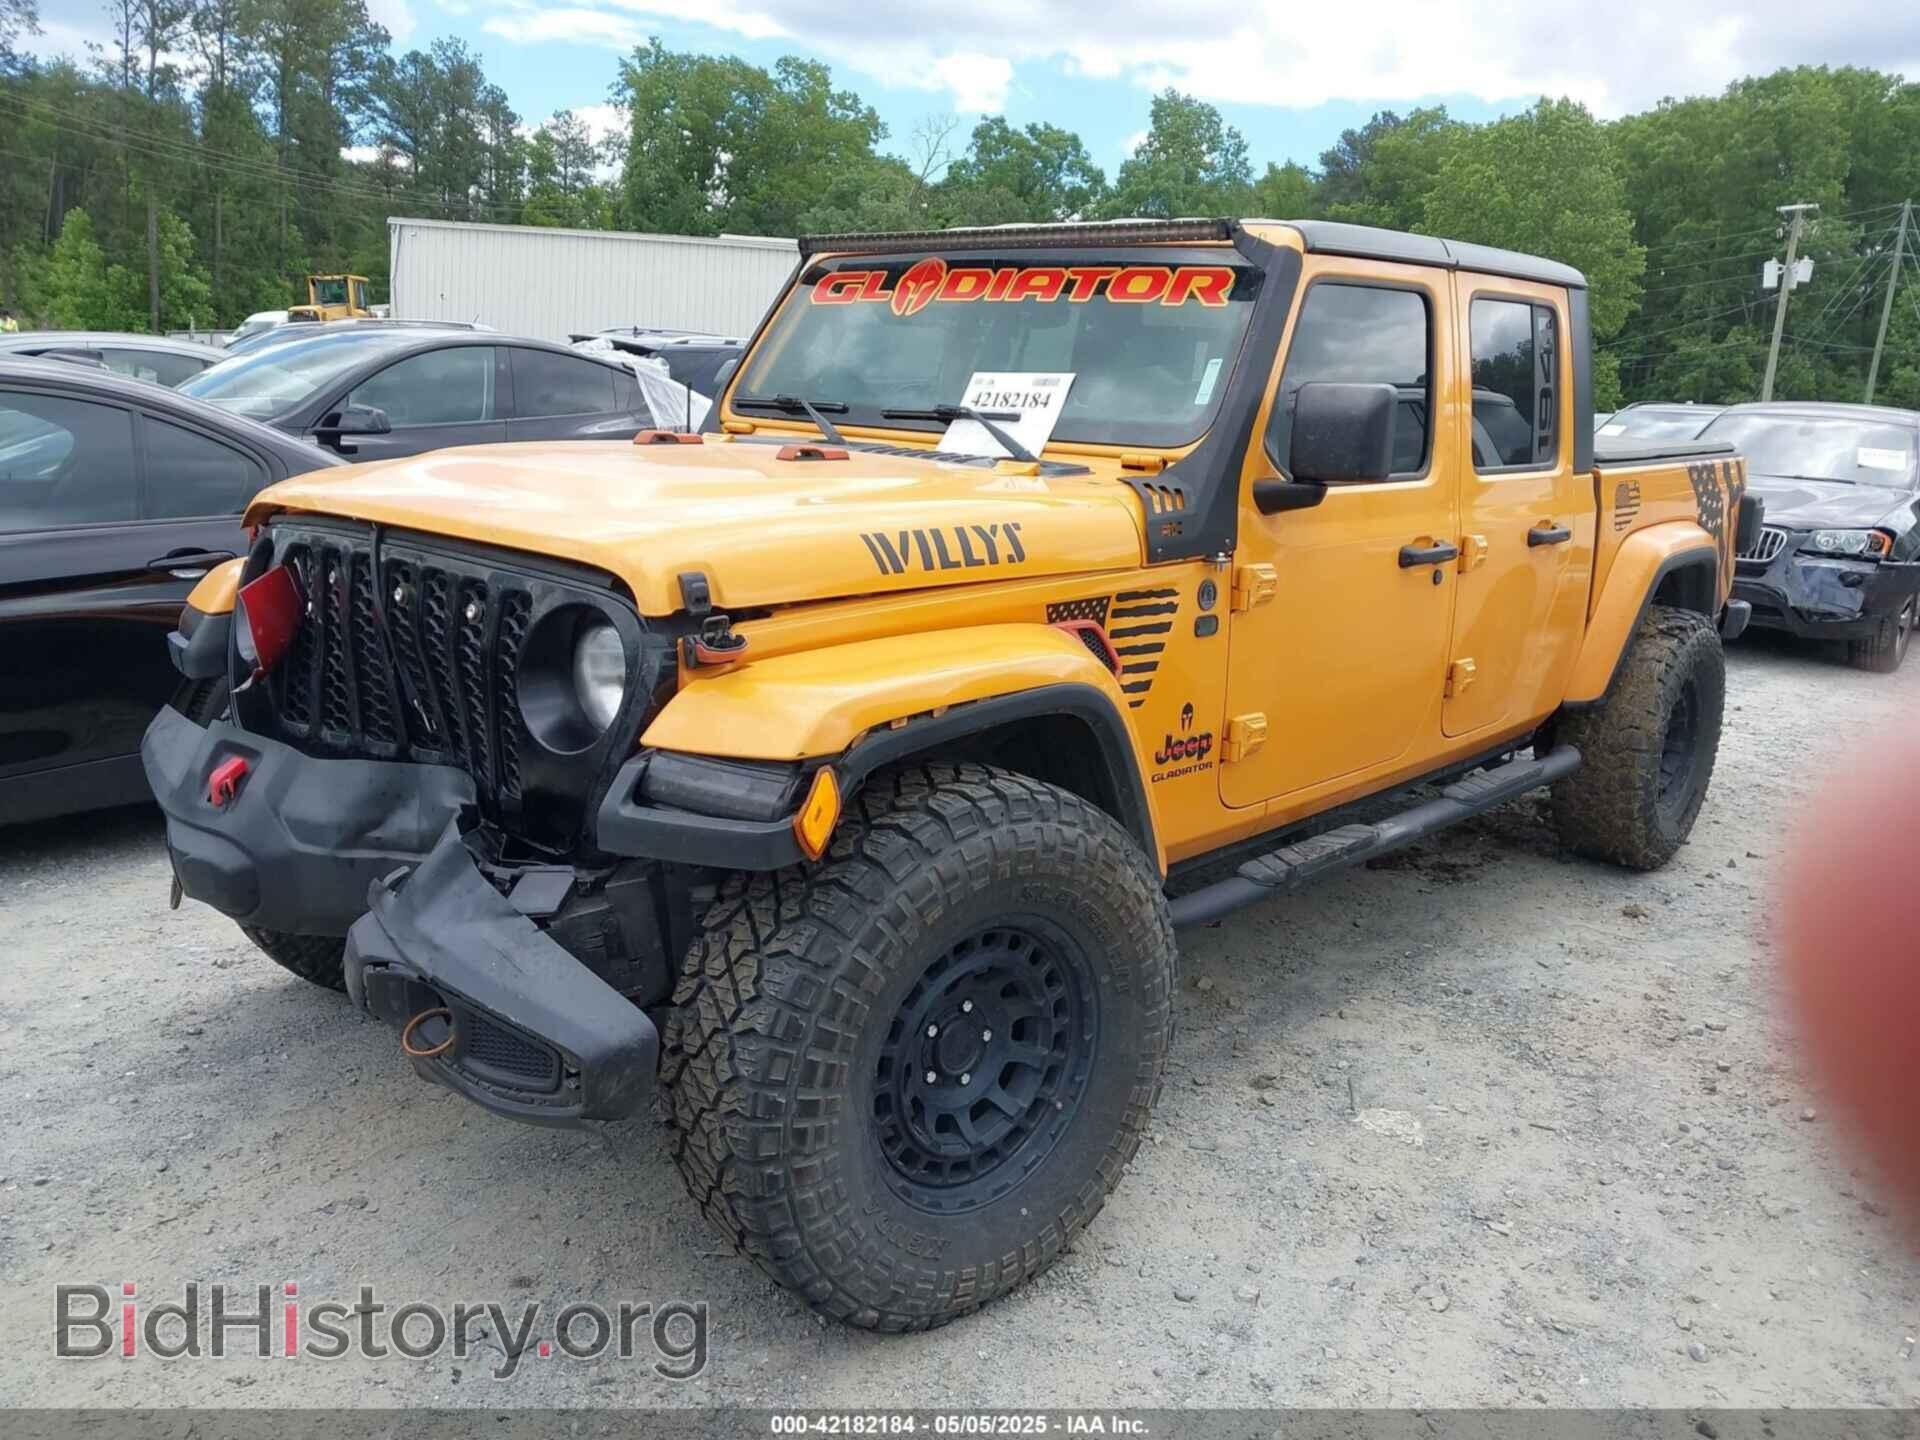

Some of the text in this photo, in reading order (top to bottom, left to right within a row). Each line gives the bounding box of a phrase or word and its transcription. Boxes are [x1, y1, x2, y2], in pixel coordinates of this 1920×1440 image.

[971, 391, 1052, 409] 42182184
[860, 522, 1026, 576] WILLYS
[1155, 731, 1213, 765] Jeep
[1151, 761, 1213, 783] GLADIATOR
